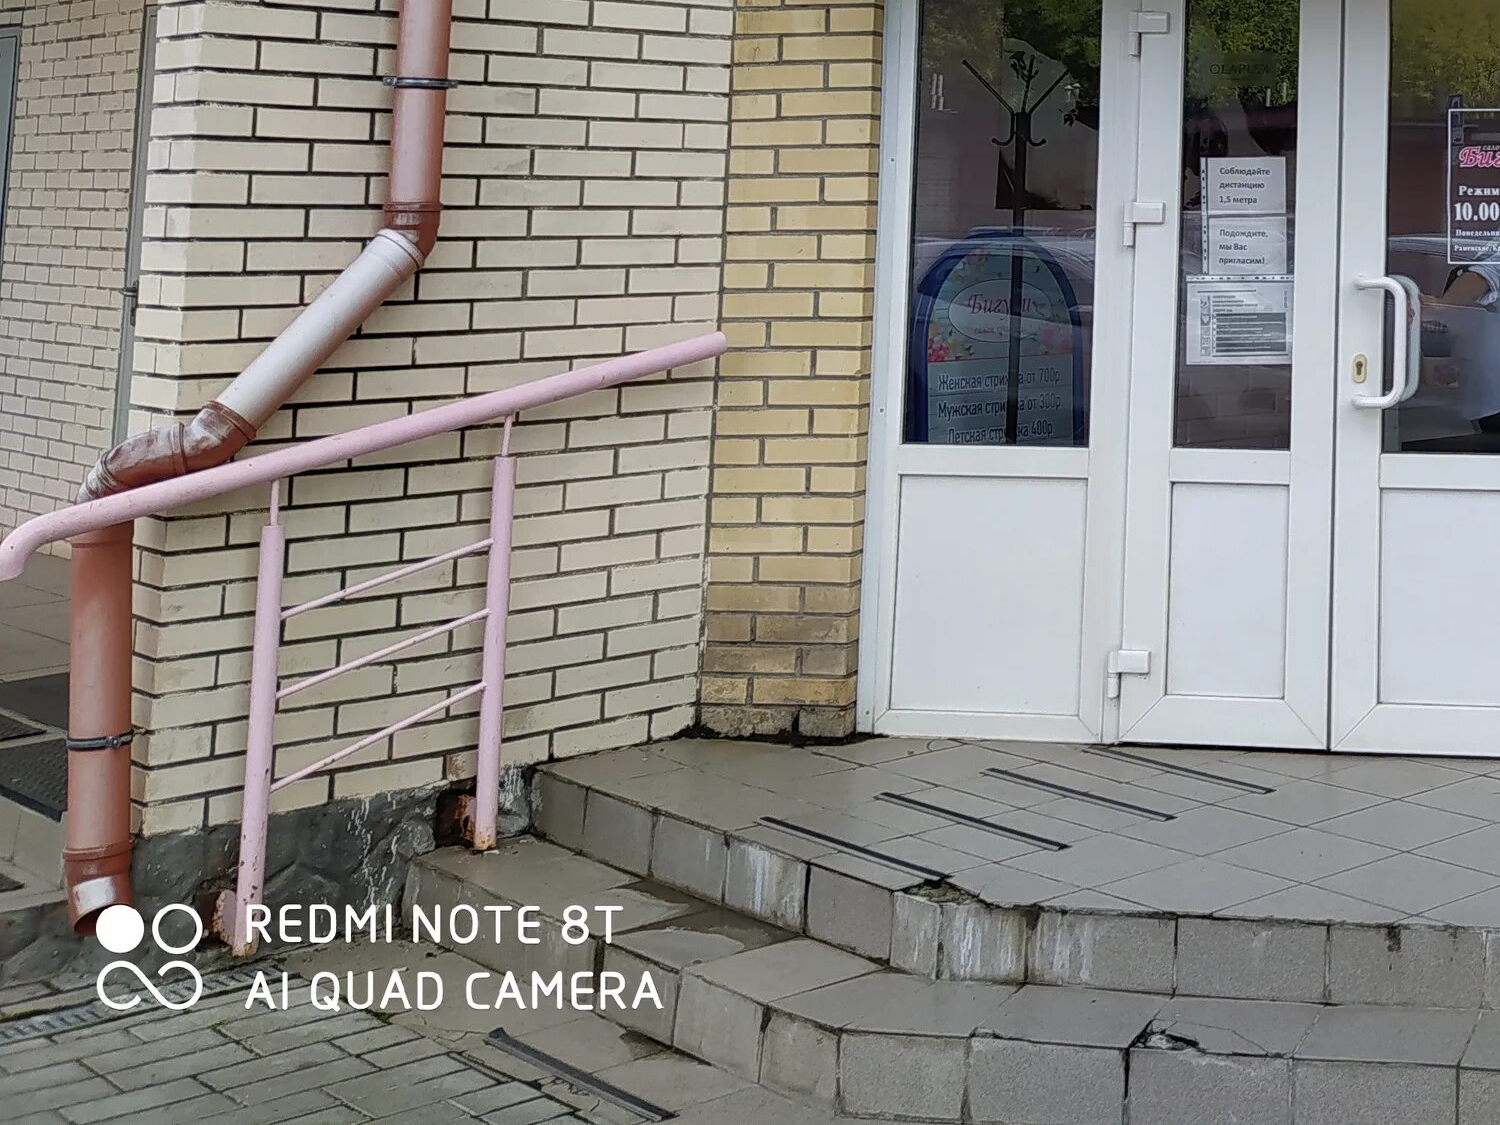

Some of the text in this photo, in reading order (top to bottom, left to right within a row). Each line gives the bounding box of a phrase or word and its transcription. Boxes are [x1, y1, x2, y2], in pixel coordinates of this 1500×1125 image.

[1219, 167, 1271, 176] Соблюдайте
[1219, 182, 1265, 190] дистанцию
[1458, 185, 1500, 196] Режим
[1219, 195, 1258, 205] 1,5 метра
[1219, 229, 1269, 238] Подождите,
[1233, 243, 1248, 251] Вас
[1219, 257, 1265, 266] пригласим!
[938, 374, 982, 391] Женская
[1027, 372, 1036, 384] от
[938, 401, 983, 422] Мужская
[1027, 398, 1038, 410] от
